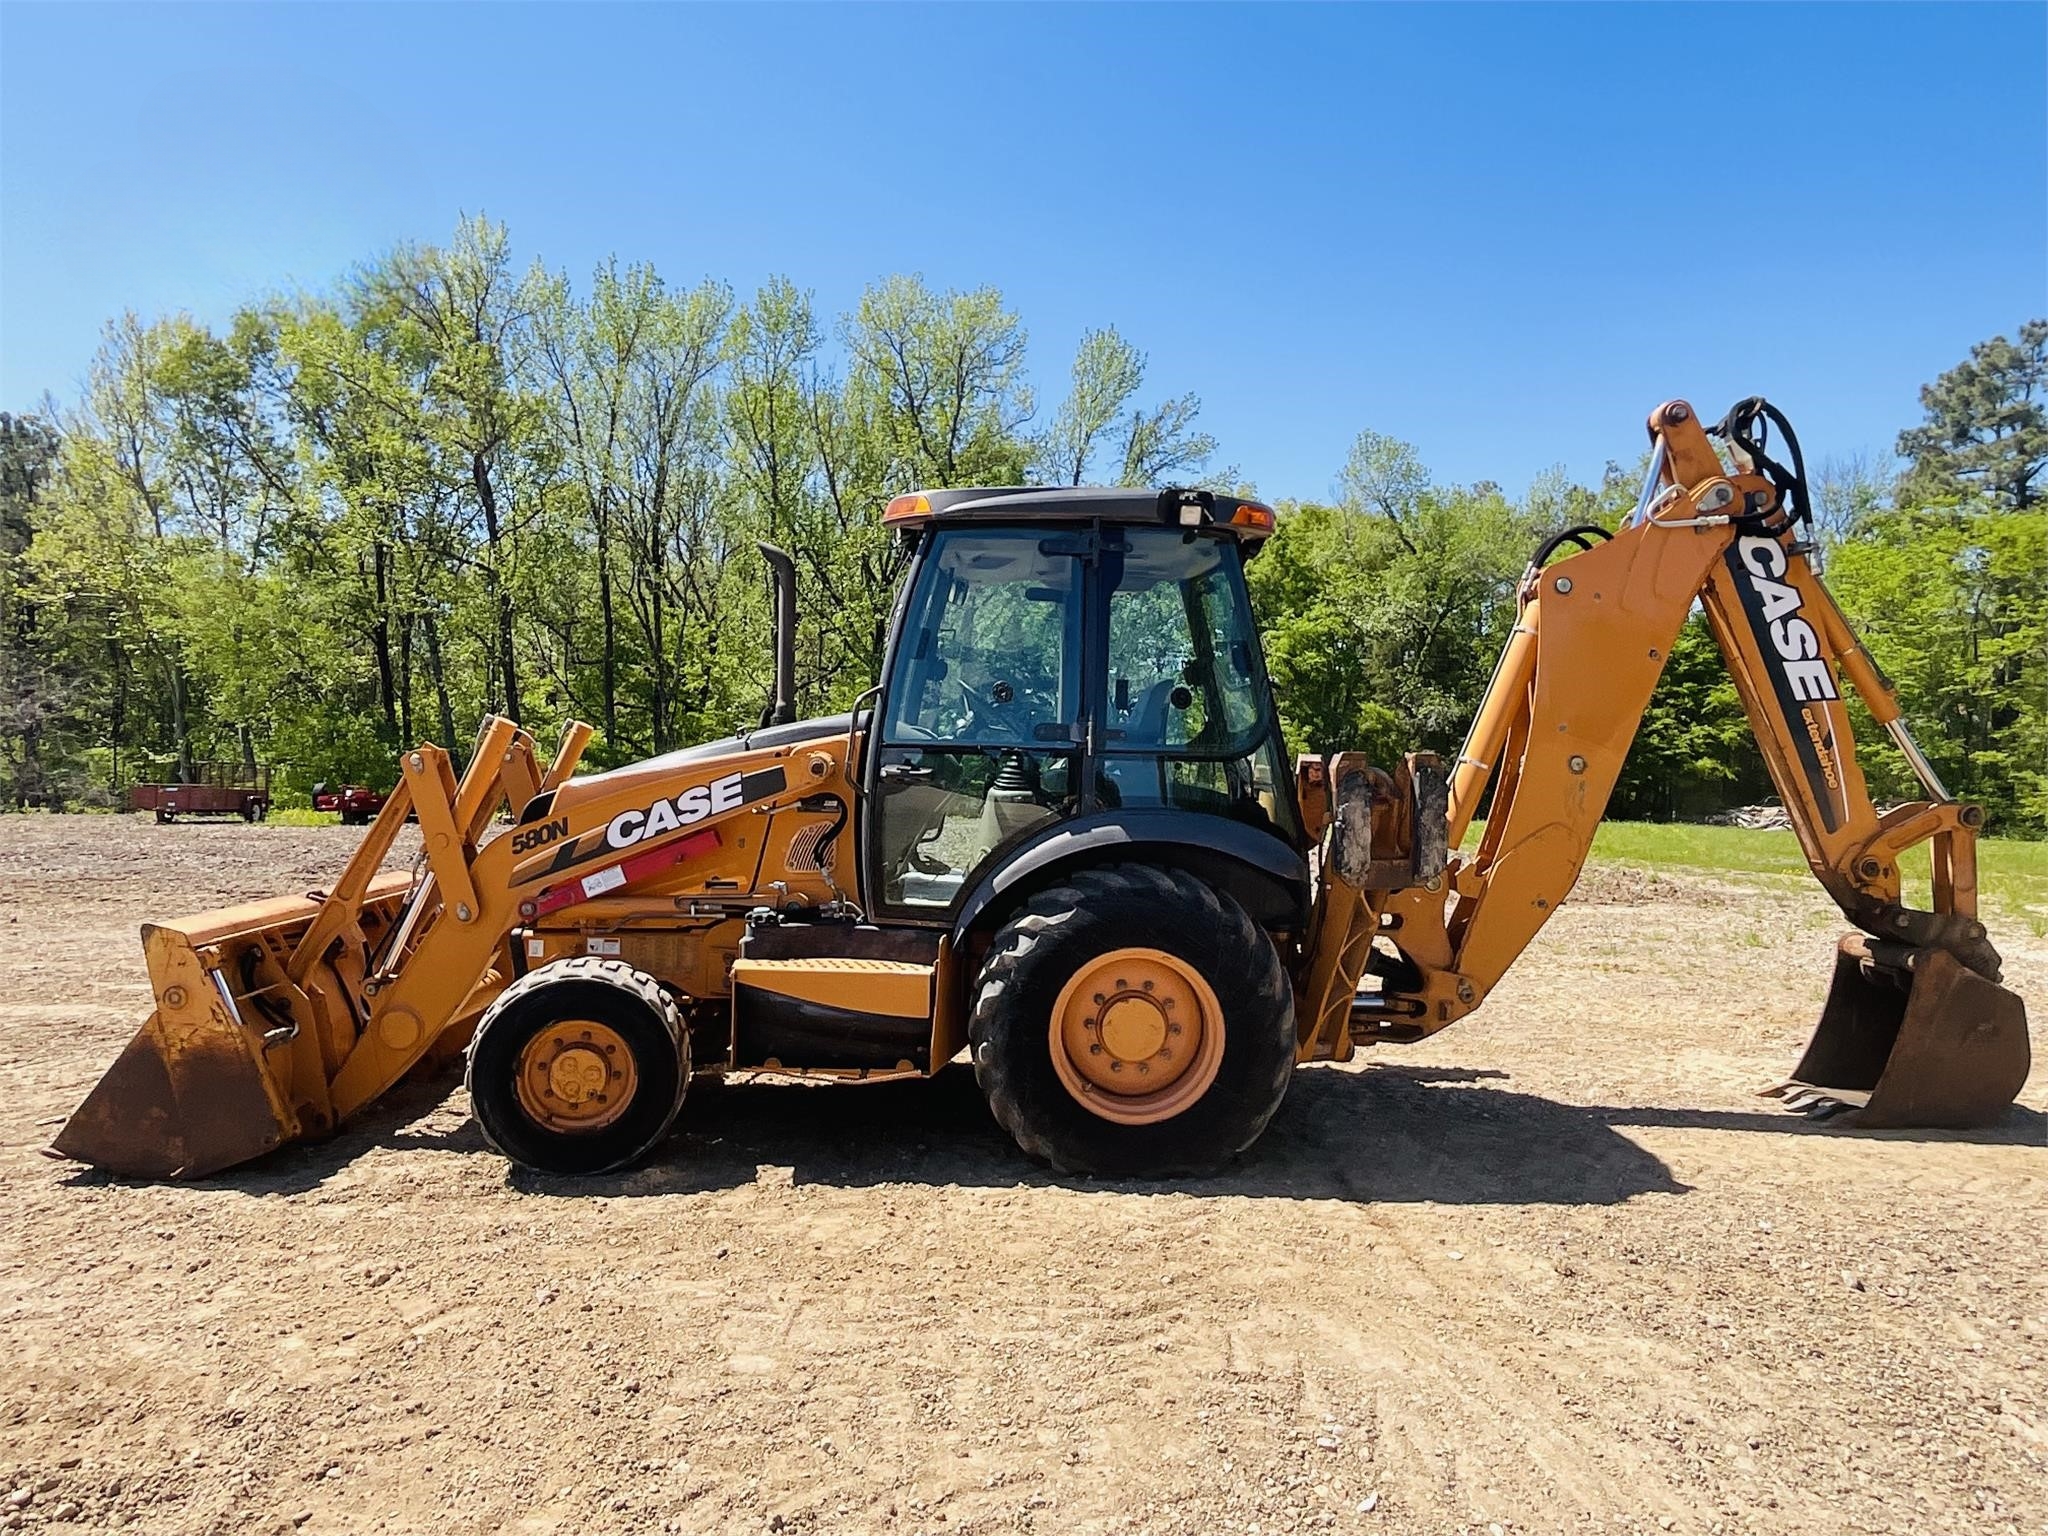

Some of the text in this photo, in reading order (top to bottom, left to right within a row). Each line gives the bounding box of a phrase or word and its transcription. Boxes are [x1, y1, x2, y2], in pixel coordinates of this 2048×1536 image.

[1739, 536, 1837, 701] CASE
[1802, 708, 1838, 788] extendahoe
[512, 818, 569, 854] 580N
[606, 772, 743, 849] CASE
